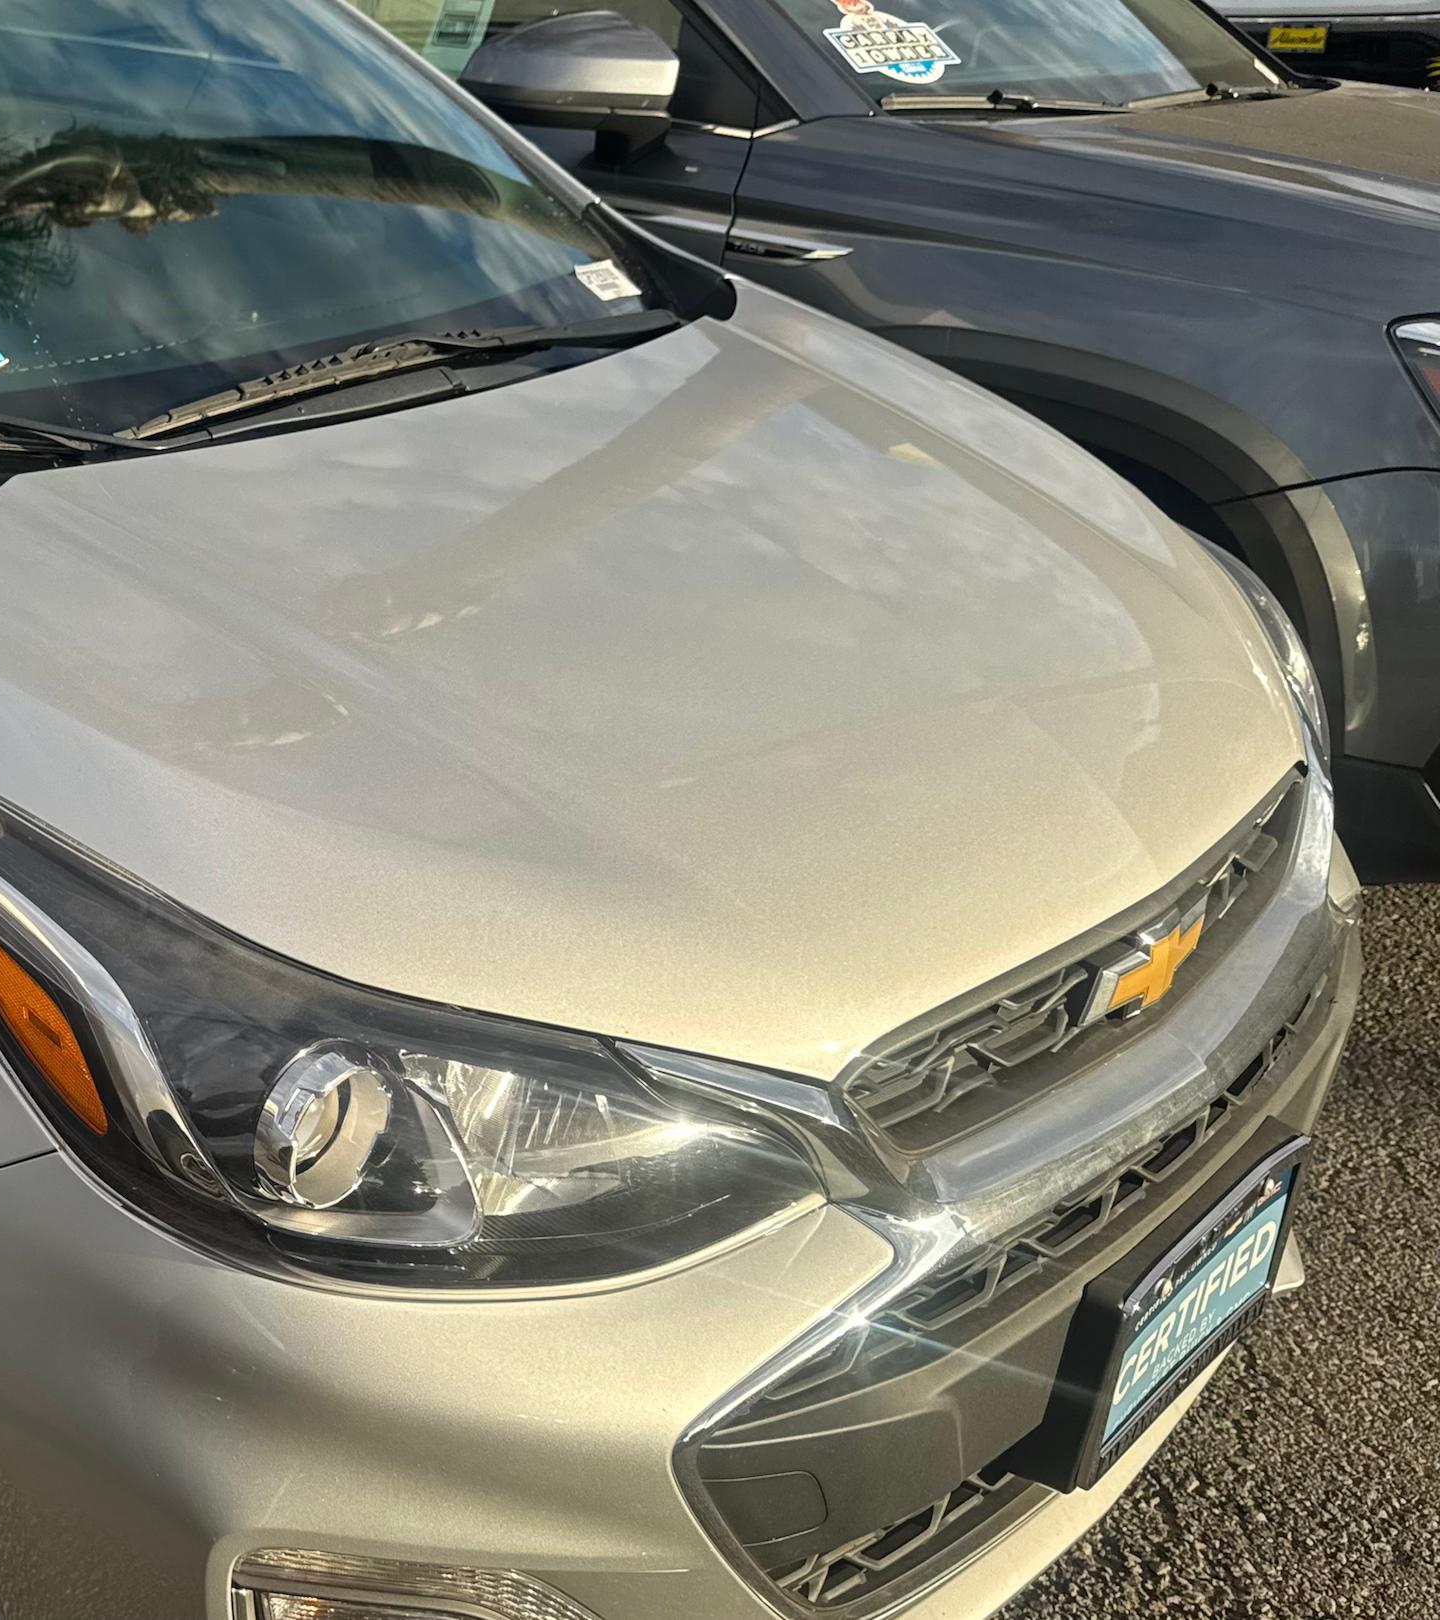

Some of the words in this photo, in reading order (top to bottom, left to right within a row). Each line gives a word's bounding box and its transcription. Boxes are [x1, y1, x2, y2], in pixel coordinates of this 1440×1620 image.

[839, 28, 935, 48] CARFAX
[869, 45, 947, 63] OWNER
[1112, 1220, 1276, 1405] CERTIFIED
[1152, 1328, 1197, 1380] BACKED
[1200, 1309, 1216, 1333] BY
